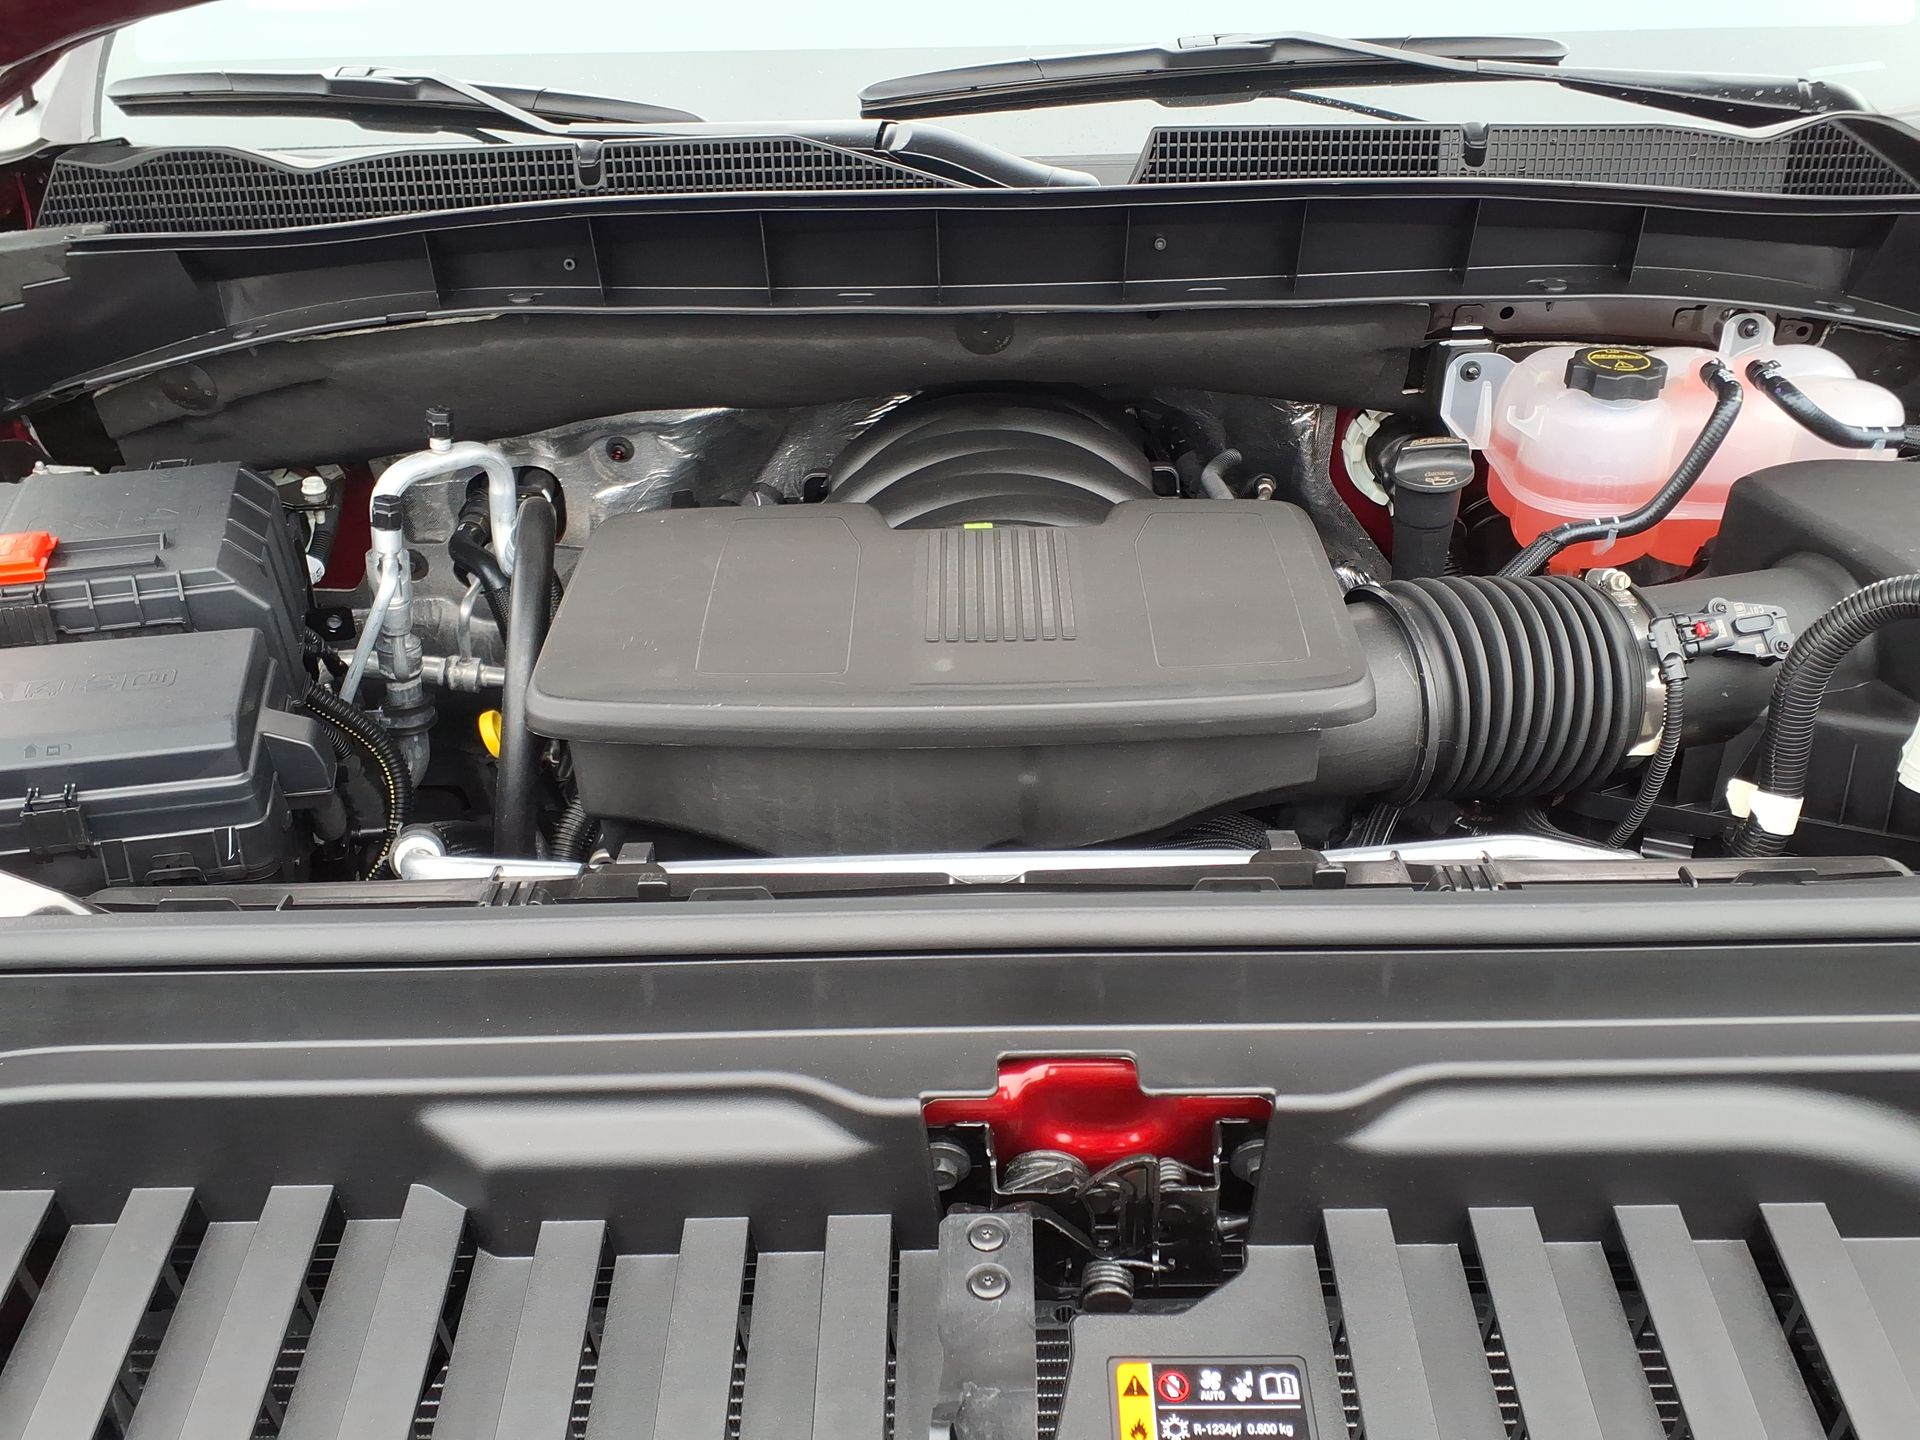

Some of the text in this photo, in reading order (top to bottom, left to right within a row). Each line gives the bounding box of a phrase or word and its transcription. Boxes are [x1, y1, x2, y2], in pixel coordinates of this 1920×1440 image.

[1200, 1391, 1226, 1401] AUTO
[1193, 1423, 1294, 1437] R-1234yf 0.600 kg
